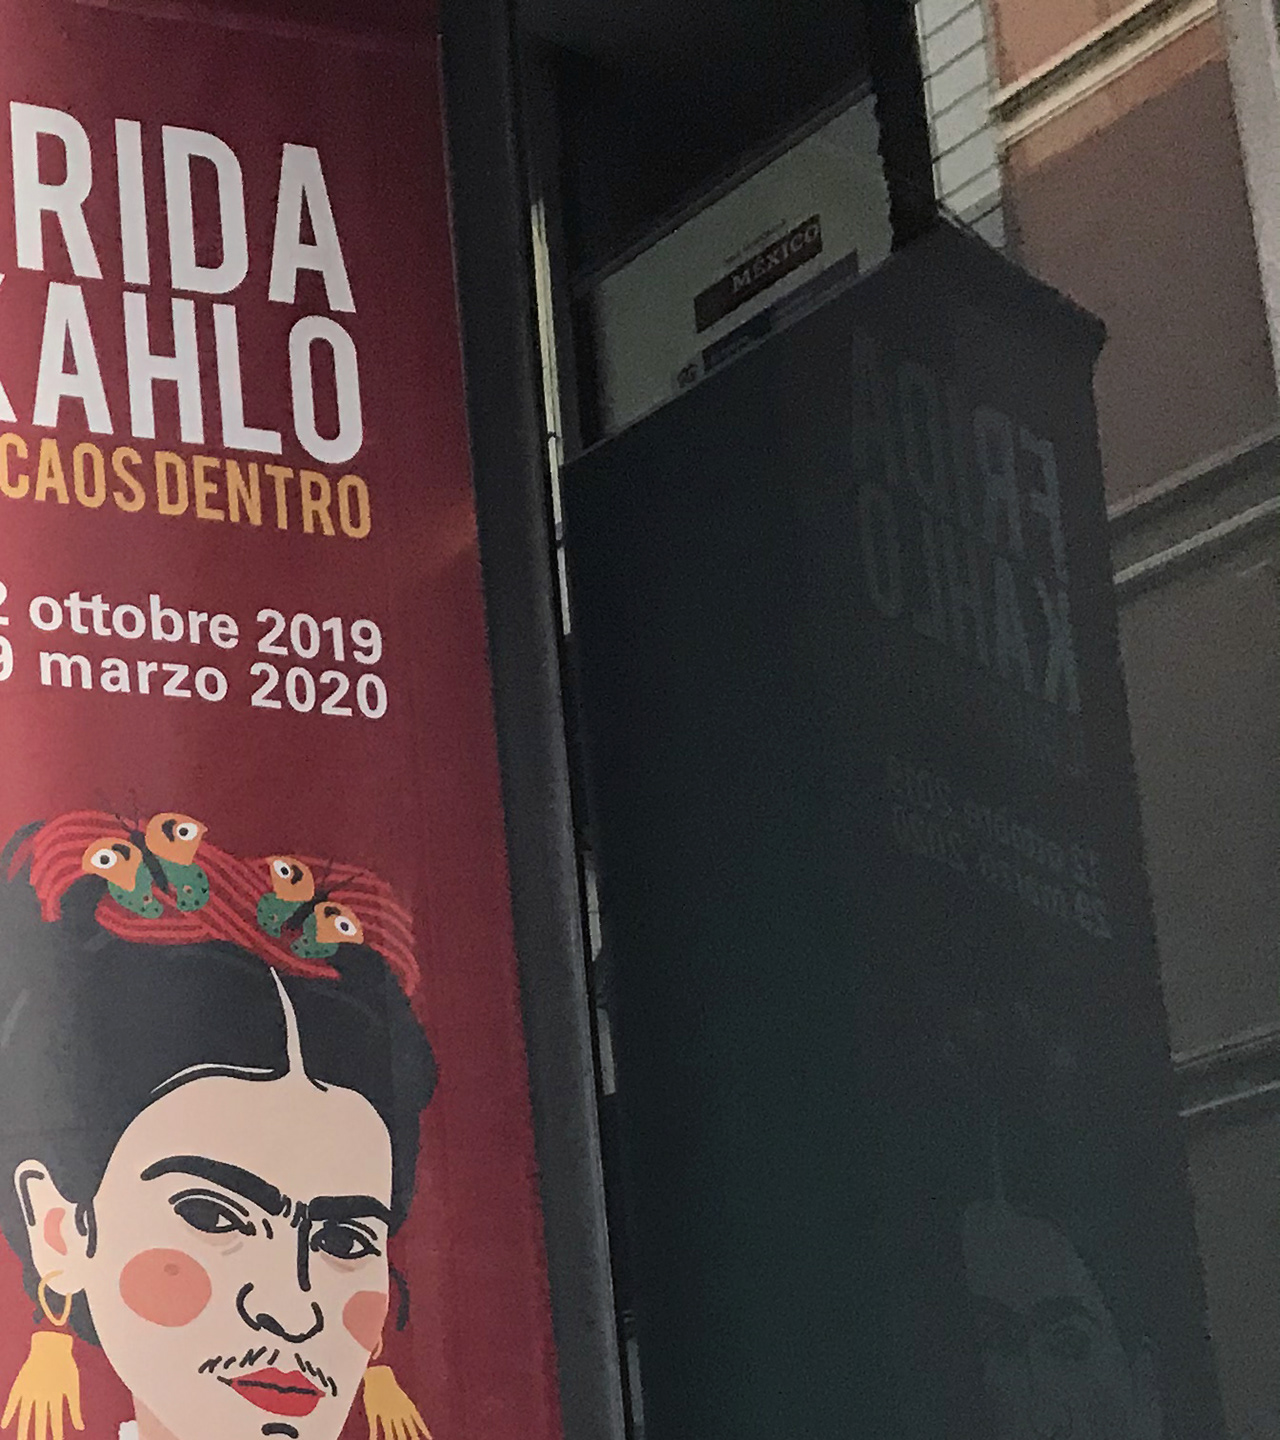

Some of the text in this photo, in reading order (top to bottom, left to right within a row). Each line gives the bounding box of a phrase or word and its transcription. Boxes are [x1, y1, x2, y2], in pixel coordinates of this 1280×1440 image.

[153, 450, 372, 539] DENTRO
[28, 589, 240, 649] ottobre
[256, 608, 383, 666] 2019
[39, 646, 230, 702] marzo
[250, 661, 389, 720] 2020
